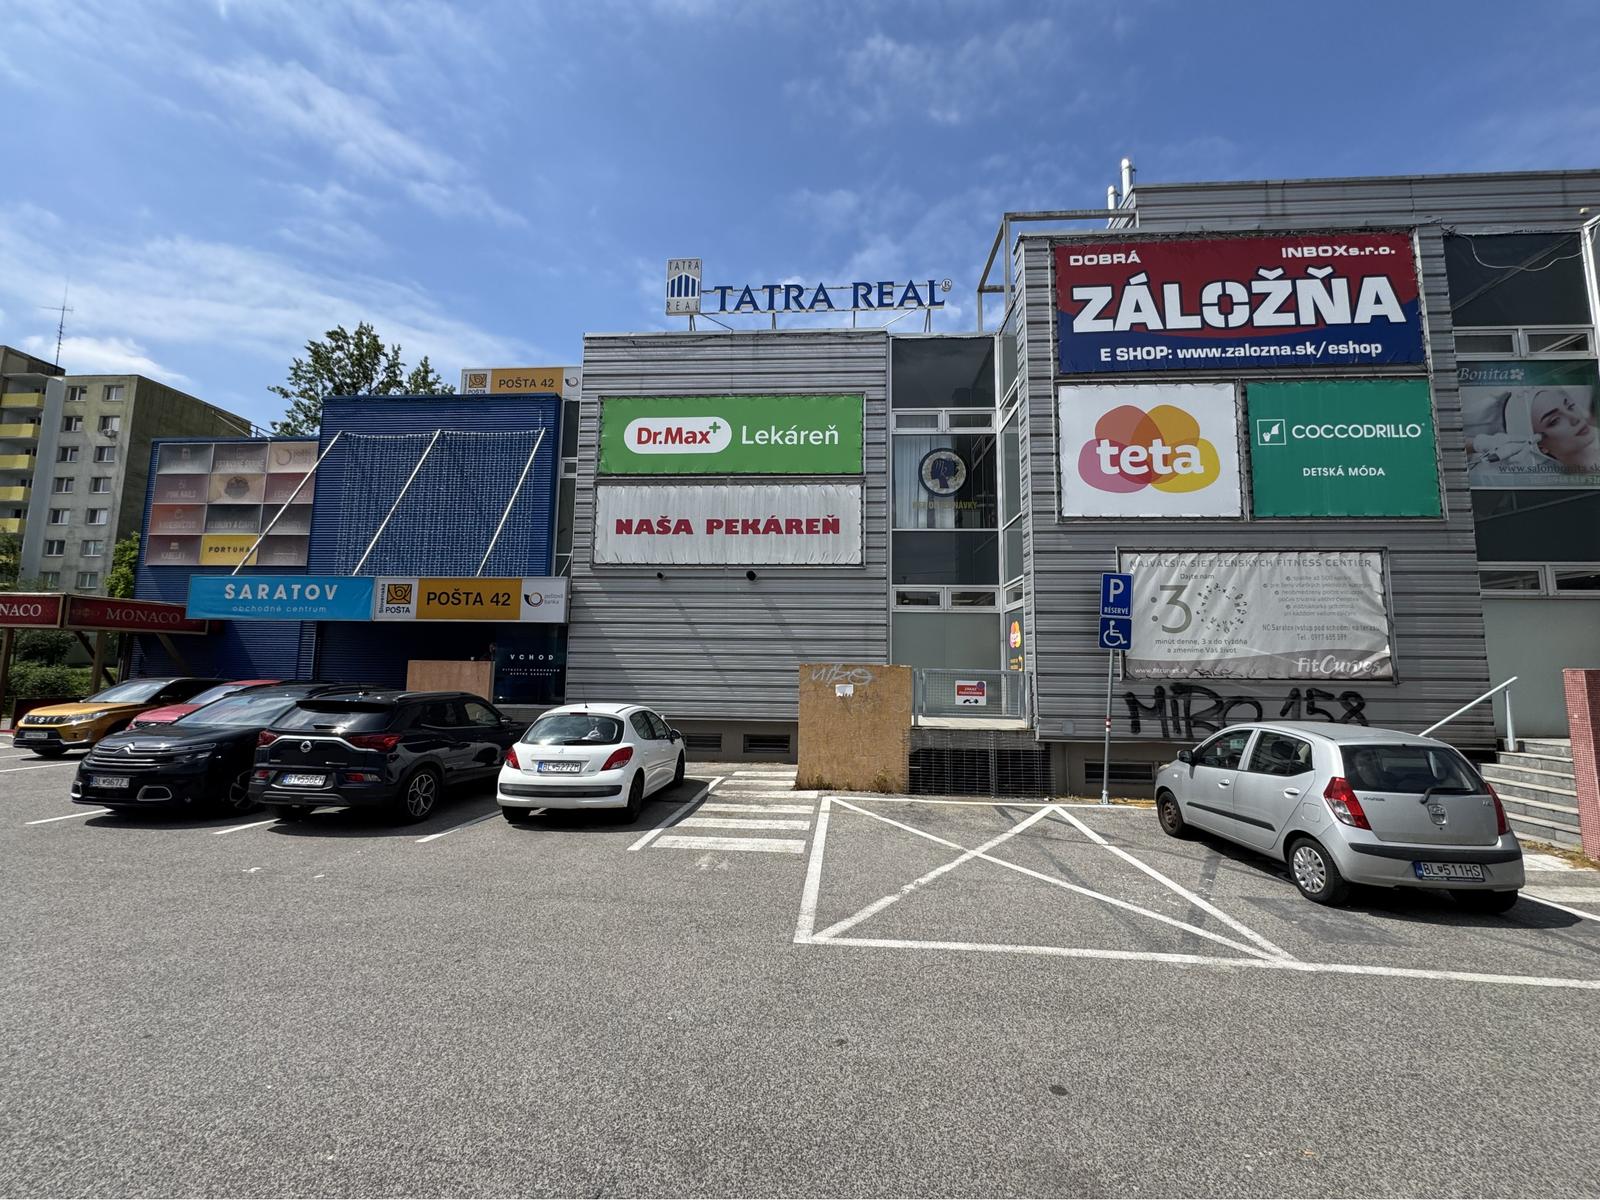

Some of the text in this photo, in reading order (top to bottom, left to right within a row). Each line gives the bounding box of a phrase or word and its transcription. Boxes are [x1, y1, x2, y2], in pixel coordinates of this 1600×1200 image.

[669, 261, 700, 271] TATRA
[1069, 250, 1142, 266] DOBRÁ
[714, 282, 836, 312] TATRA
[1072, 265, 1407, 333] ZÁLOŽŇA
[667, 301, 700, 312] REAL
[1100, 340, 1382, 362] E SHOP: www.zalozna.sk/eshop
[498, 376, 555, 388] POŠTA 42
[1459, 367, 1509, 381] Bonita
[741, 424, 839, 445] Lekáreň
[1291, 423, 1422, 439] COCCODRILLO
[1095, 438, 1205, 476] teta
[1303, 464, 1386, 477] DETSKÁ MÓDA
[615, 514, 840, 535] NAŠA PEKÁREŇ
[1276, 559, 1322, 568] FITNESS
[1325, 559, 1372, 567] CENTIER
[224, 583, 339, 600] SARATOV
[426, 588, 511, 606] POŠTA 42
[1109, 578, 1125, 603] P
[106, 607, 181, 624] MONACO
[232, 604, 327, 613] obchodné centrum
[385, 605, 411, 614] POŠTA
